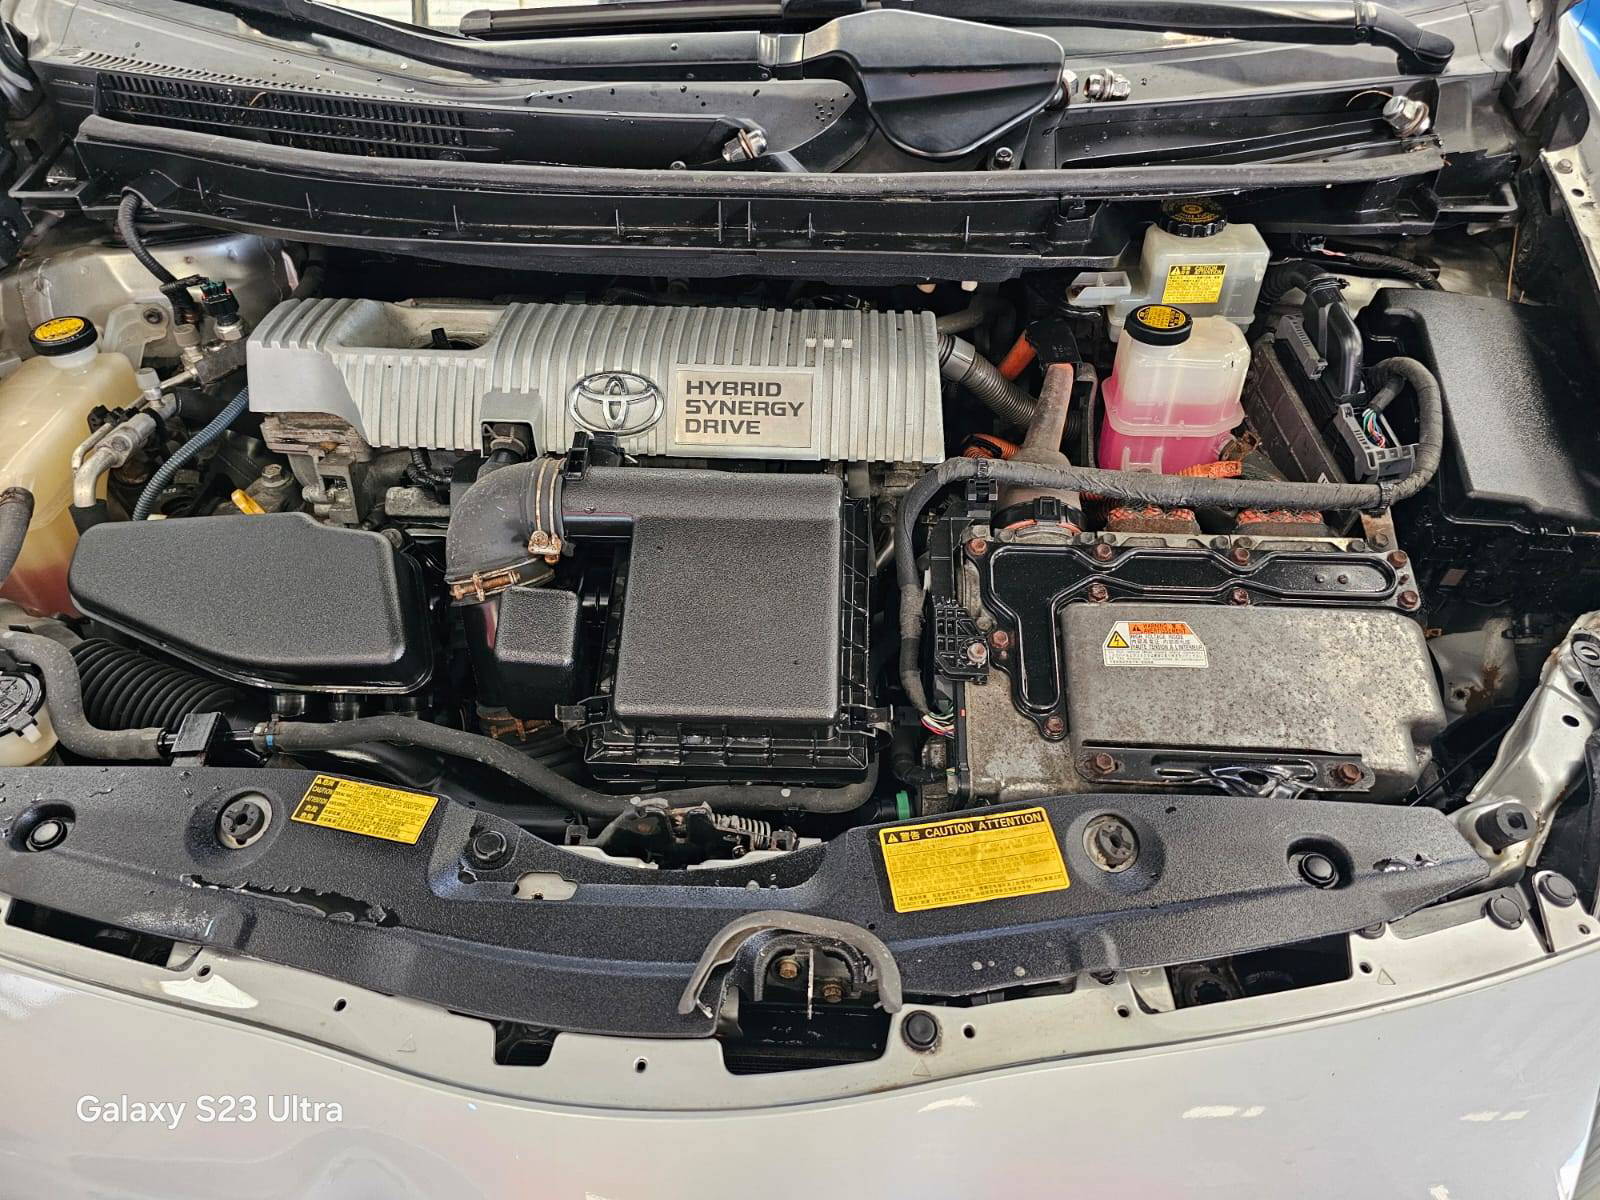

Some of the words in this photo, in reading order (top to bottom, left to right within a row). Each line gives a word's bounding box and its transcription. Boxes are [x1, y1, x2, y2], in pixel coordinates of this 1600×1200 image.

[686, 380, 782, 397] HYBRID
[685, 399, 805, 417] SYNERGY
[685, 418, 761, 435] DRIVE
[925, 822, 974, 839] CAUTION
[978, 812, 1042, 831] ATTENTION
